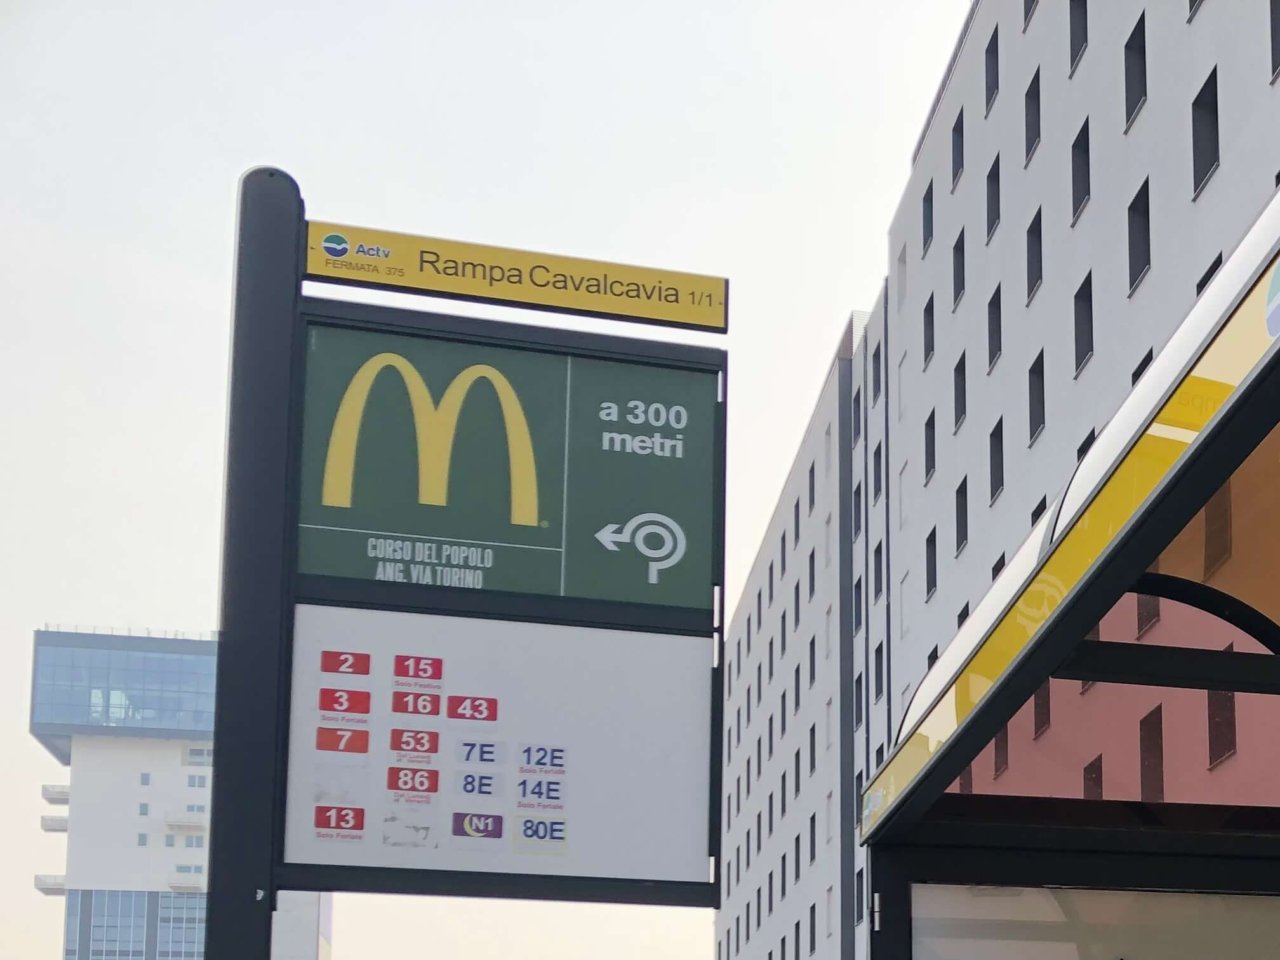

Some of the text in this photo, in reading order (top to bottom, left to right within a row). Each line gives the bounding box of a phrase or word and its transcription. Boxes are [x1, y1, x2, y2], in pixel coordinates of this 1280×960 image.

[355, 243, 391, 259] Actv
[325, 258, 405, 277] FERMATA 375
[418, 250, 714, 308] Rampa Cavalcavia 1/1
[599, 400, 688, 429] a 300
[602, 430, 684, 458] metri
[367, 537, 493, 568] CORSO DEL POPOLO
[375, 561, 483, 589] ANG. VIA TORINO
[338, 653, 354, 673] 2
[404, 658, 433, 678] 15
[333, 691, 349, 711] 3
[403, 694, 432, 714] 16
[457, 699, 488, 719] 43
[336, 730, 353, 751] 7
[400, 731, 430, 752] 53
[462, 743, 495, 762] 7E
[522, 747, 564, 767] 12E
[398, 769, 429, 790] 86
[462, 774, 493, 795] 8E
[517, 779, 560, 800] 14E
[325, 808, 355, 828] 13
[471, 816, 494, 831] N1
[523, 819, 565, 840] 80E
